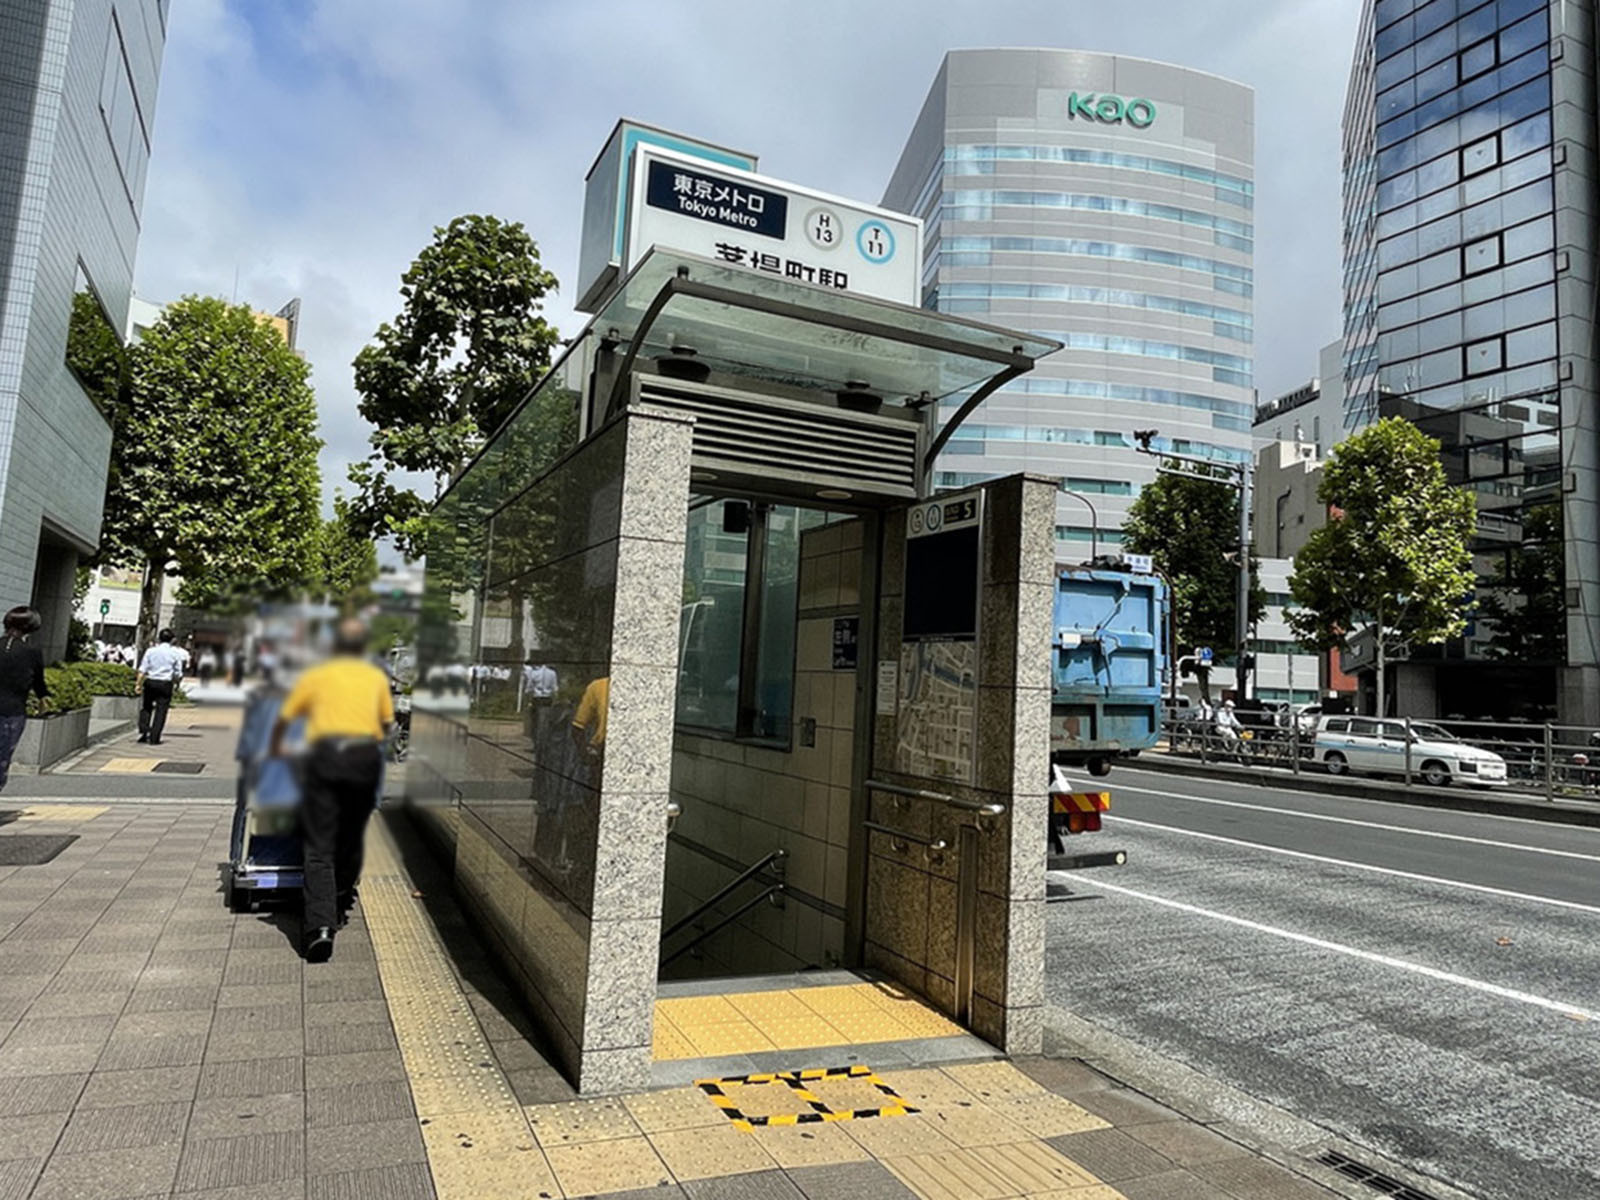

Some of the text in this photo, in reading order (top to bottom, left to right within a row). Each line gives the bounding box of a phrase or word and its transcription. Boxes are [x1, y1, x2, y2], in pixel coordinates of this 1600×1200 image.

[673, 174, 764, 213] 東京メトロ
[678, 195, 758, 228] Tokyo Metro
[819, 214, 830, 227] H
[815, 227, 833, 243] 13
[872, 228, 881, 240] T
[867, 241, 884, 256] 11
